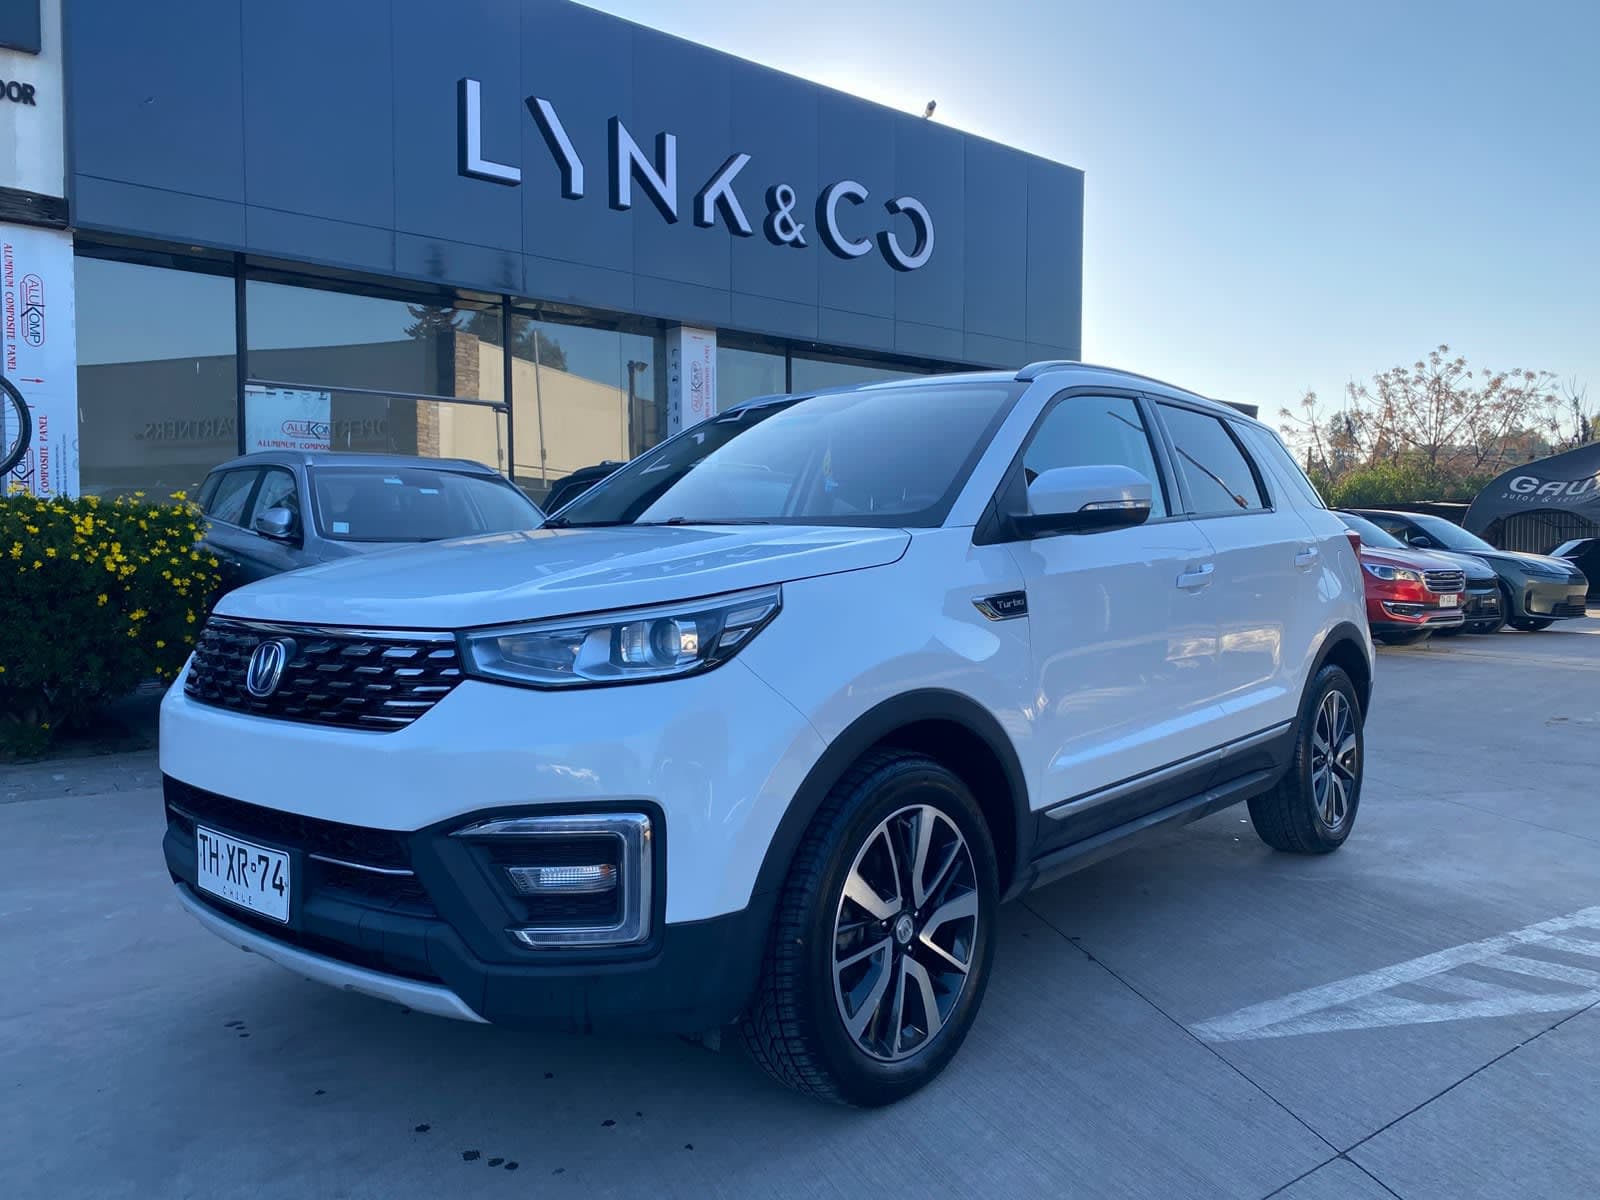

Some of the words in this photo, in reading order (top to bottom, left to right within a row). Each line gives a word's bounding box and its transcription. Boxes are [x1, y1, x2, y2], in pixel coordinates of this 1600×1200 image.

[4, 242, 14, 289] ALUMINUM
[4, 291, 16, 340] COMPOSITE
[20, 278, 45, 344] ALUKOMP
[7, 344, 17, 372] PANEL
[38, 415, 48, 442] PANEL
[257, 439, 296, 448] ALUMINUM
[39, 446, 49, 494] COMPOSITE
[996, 599, 1025, 609] Turbo
[222, 885, 253, 905] CHILE
